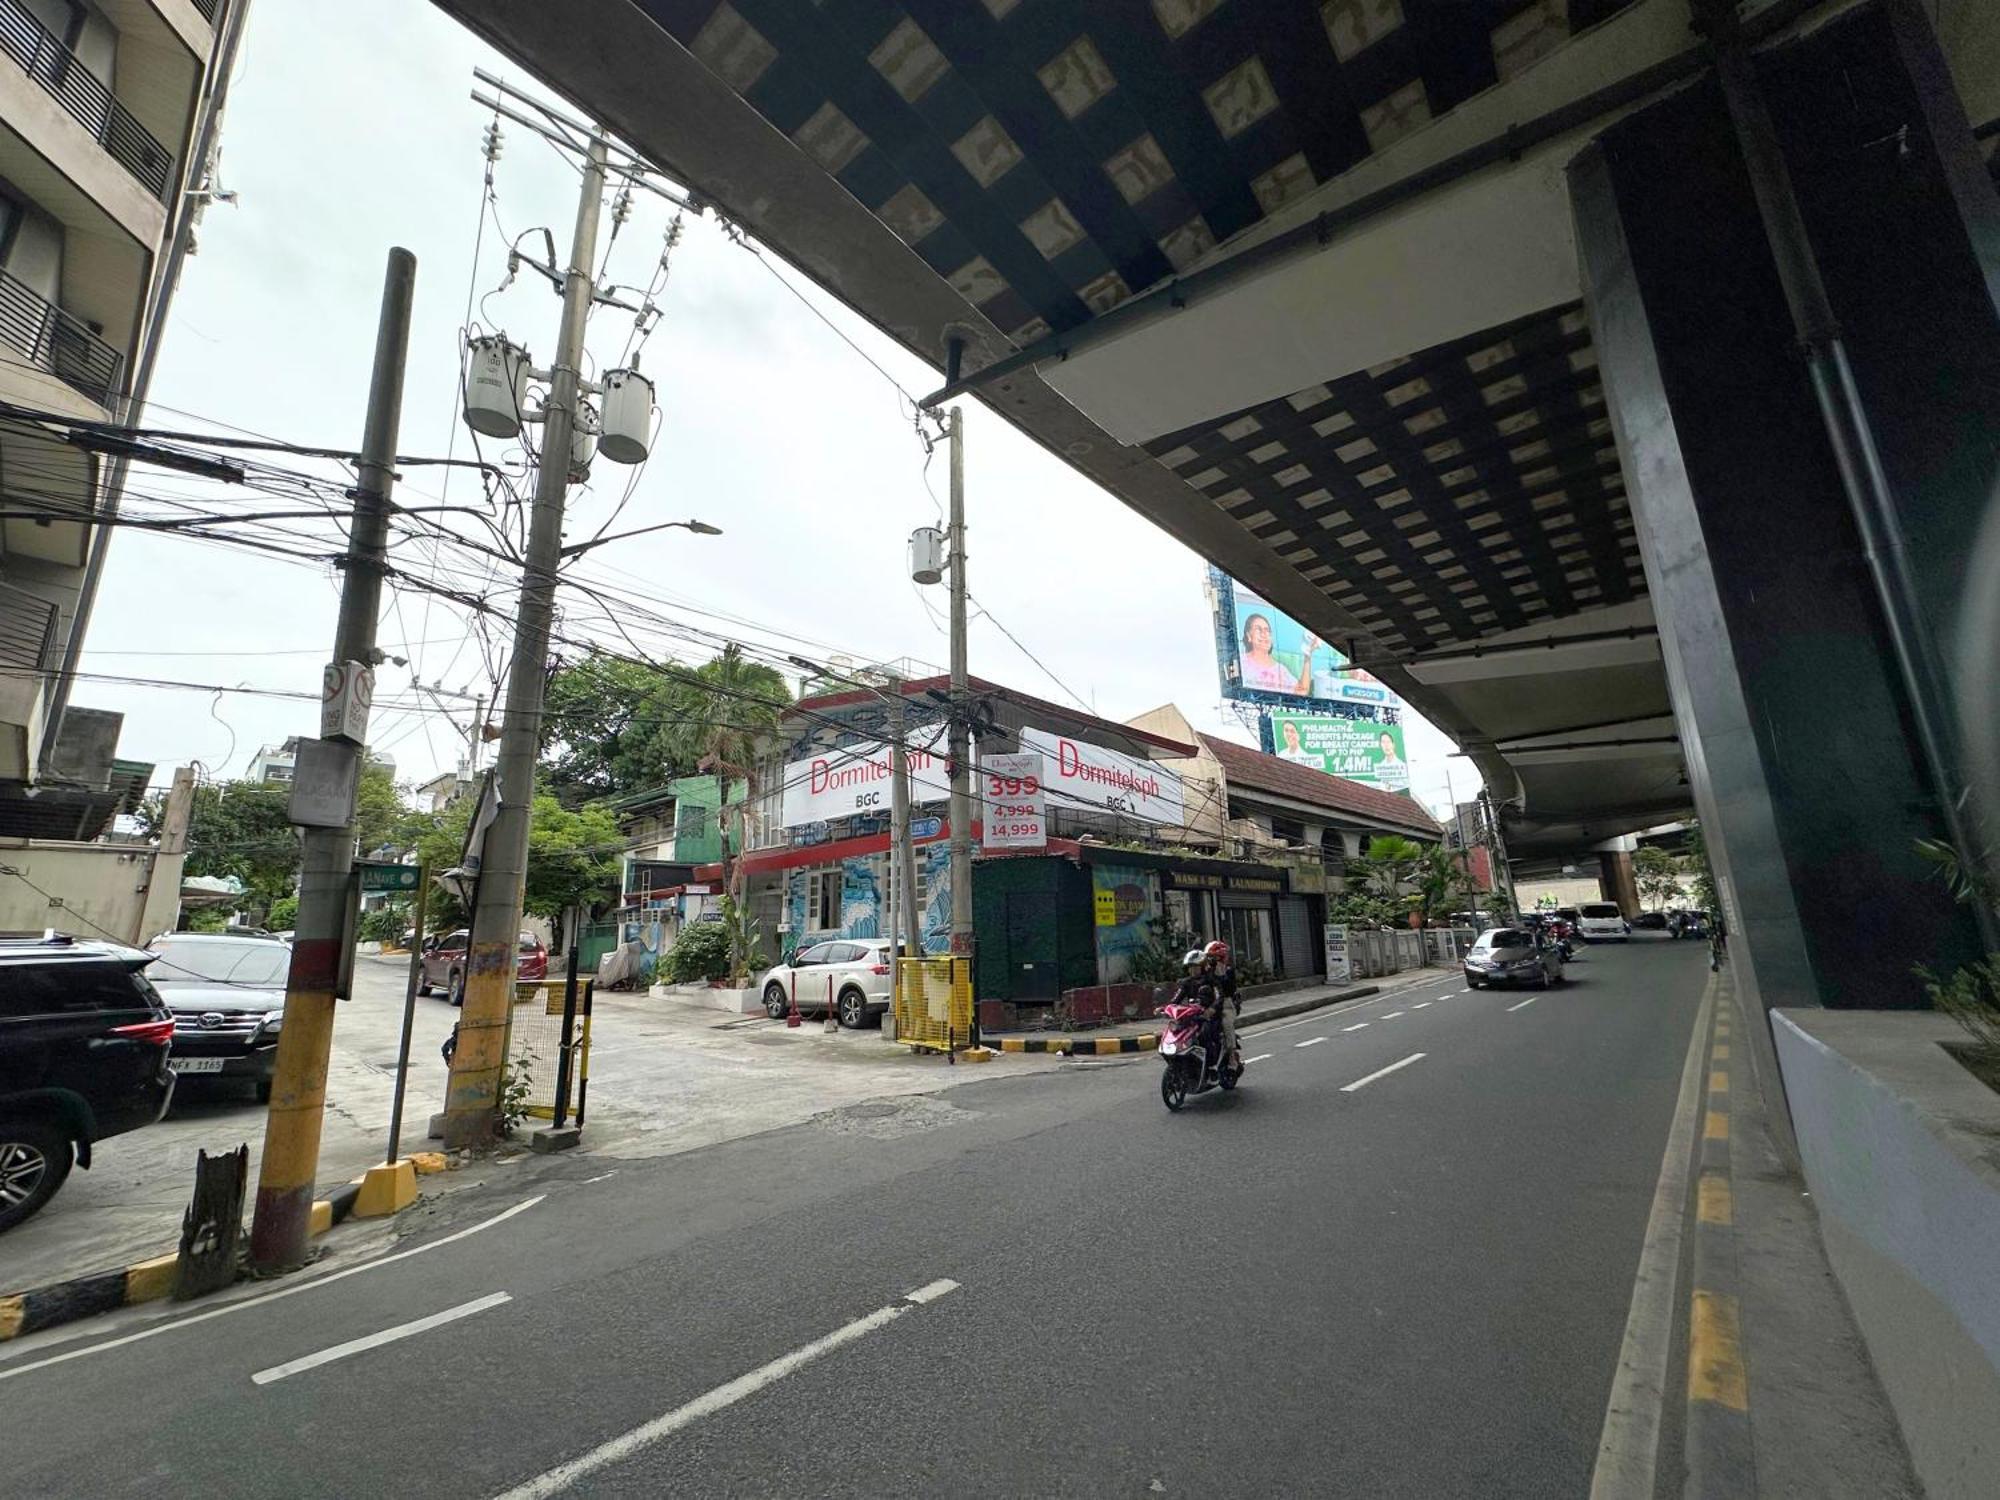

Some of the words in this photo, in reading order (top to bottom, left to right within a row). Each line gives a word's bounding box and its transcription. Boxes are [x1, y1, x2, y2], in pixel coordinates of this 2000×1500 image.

[1306, 732, 1342, 741] BENEFITS
[1342, 732, 1376, 741] PACKAGE
[1305, 740, 1321, 749] FOR
[1322, 740, 1349, 749] BREAST
[1350, 740, 1380, 749] CANCER
[811, 744, 931, 795] Dormitelph
[1060, 740, 1159, 801] Dormitelsph
[1332, 756, 1373, 773] 1.4M!
[988, 775, 1039, 797] 399
[855, 792, 880, 808] BGC
[1106, 796, 1127, 811] BGC
[994, 804, 1035, 818] 4,999
[991, 823, 1039, 838] 14,999
